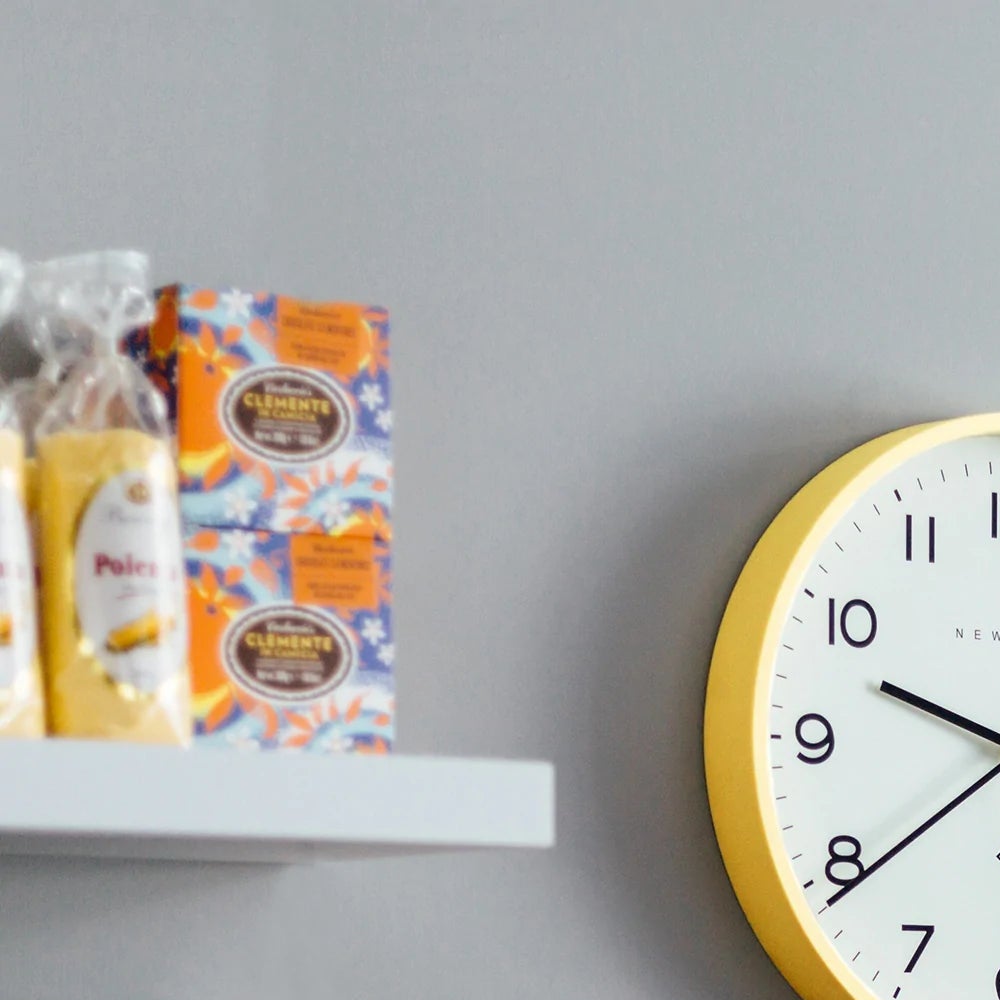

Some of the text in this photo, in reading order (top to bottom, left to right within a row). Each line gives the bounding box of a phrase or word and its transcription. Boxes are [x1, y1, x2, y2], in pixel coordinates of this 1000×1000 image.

[905, 514, 935, 563] 11
[828, 598, 877, 648] 10
[795, 713, 835, 765] 9
[824, 834, 865, 887] 8
[901, 924, 935, 973] 7
